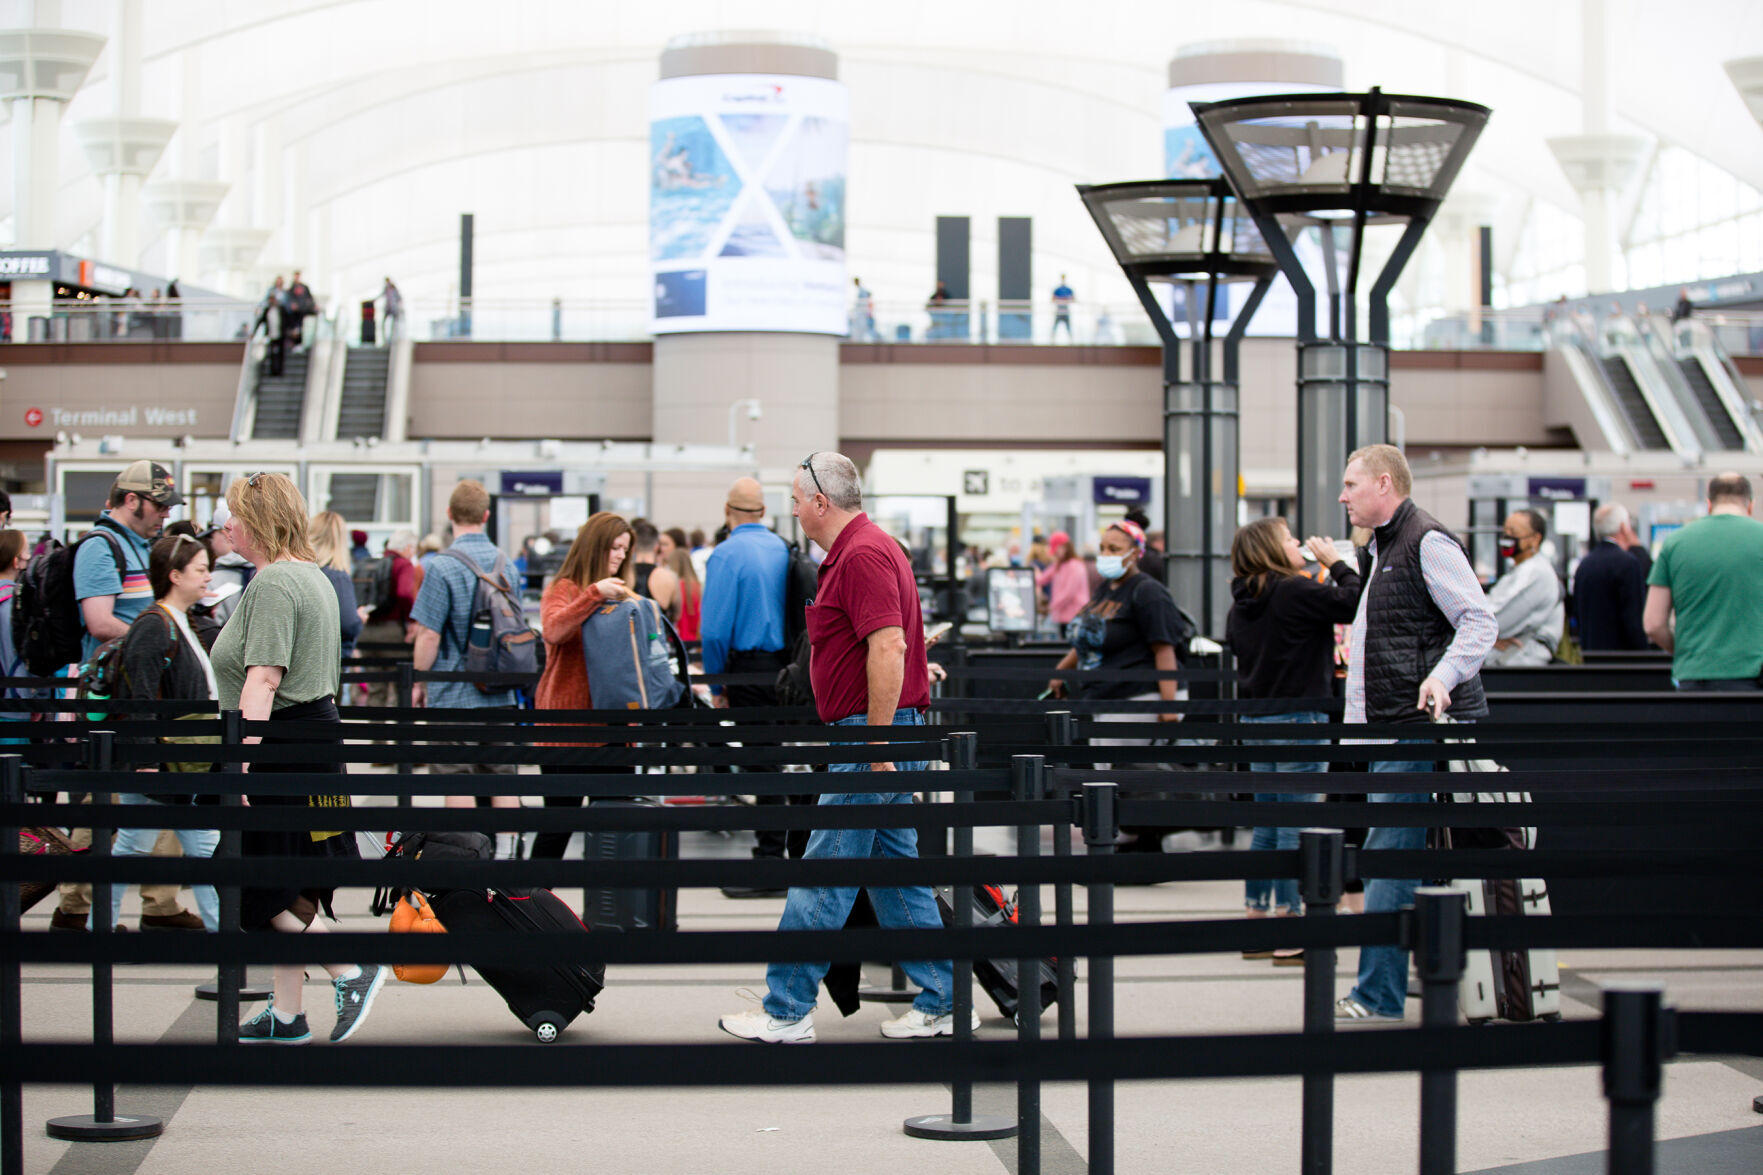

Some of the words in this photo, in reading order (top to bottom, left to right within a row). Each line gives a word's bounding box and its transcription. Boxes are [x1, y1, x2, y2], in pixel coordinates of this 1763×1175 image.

[0, 257, 49, 273] OFFEE
[51, 407, 137, 425] Terminal
[144, 408, 197, 425] West
